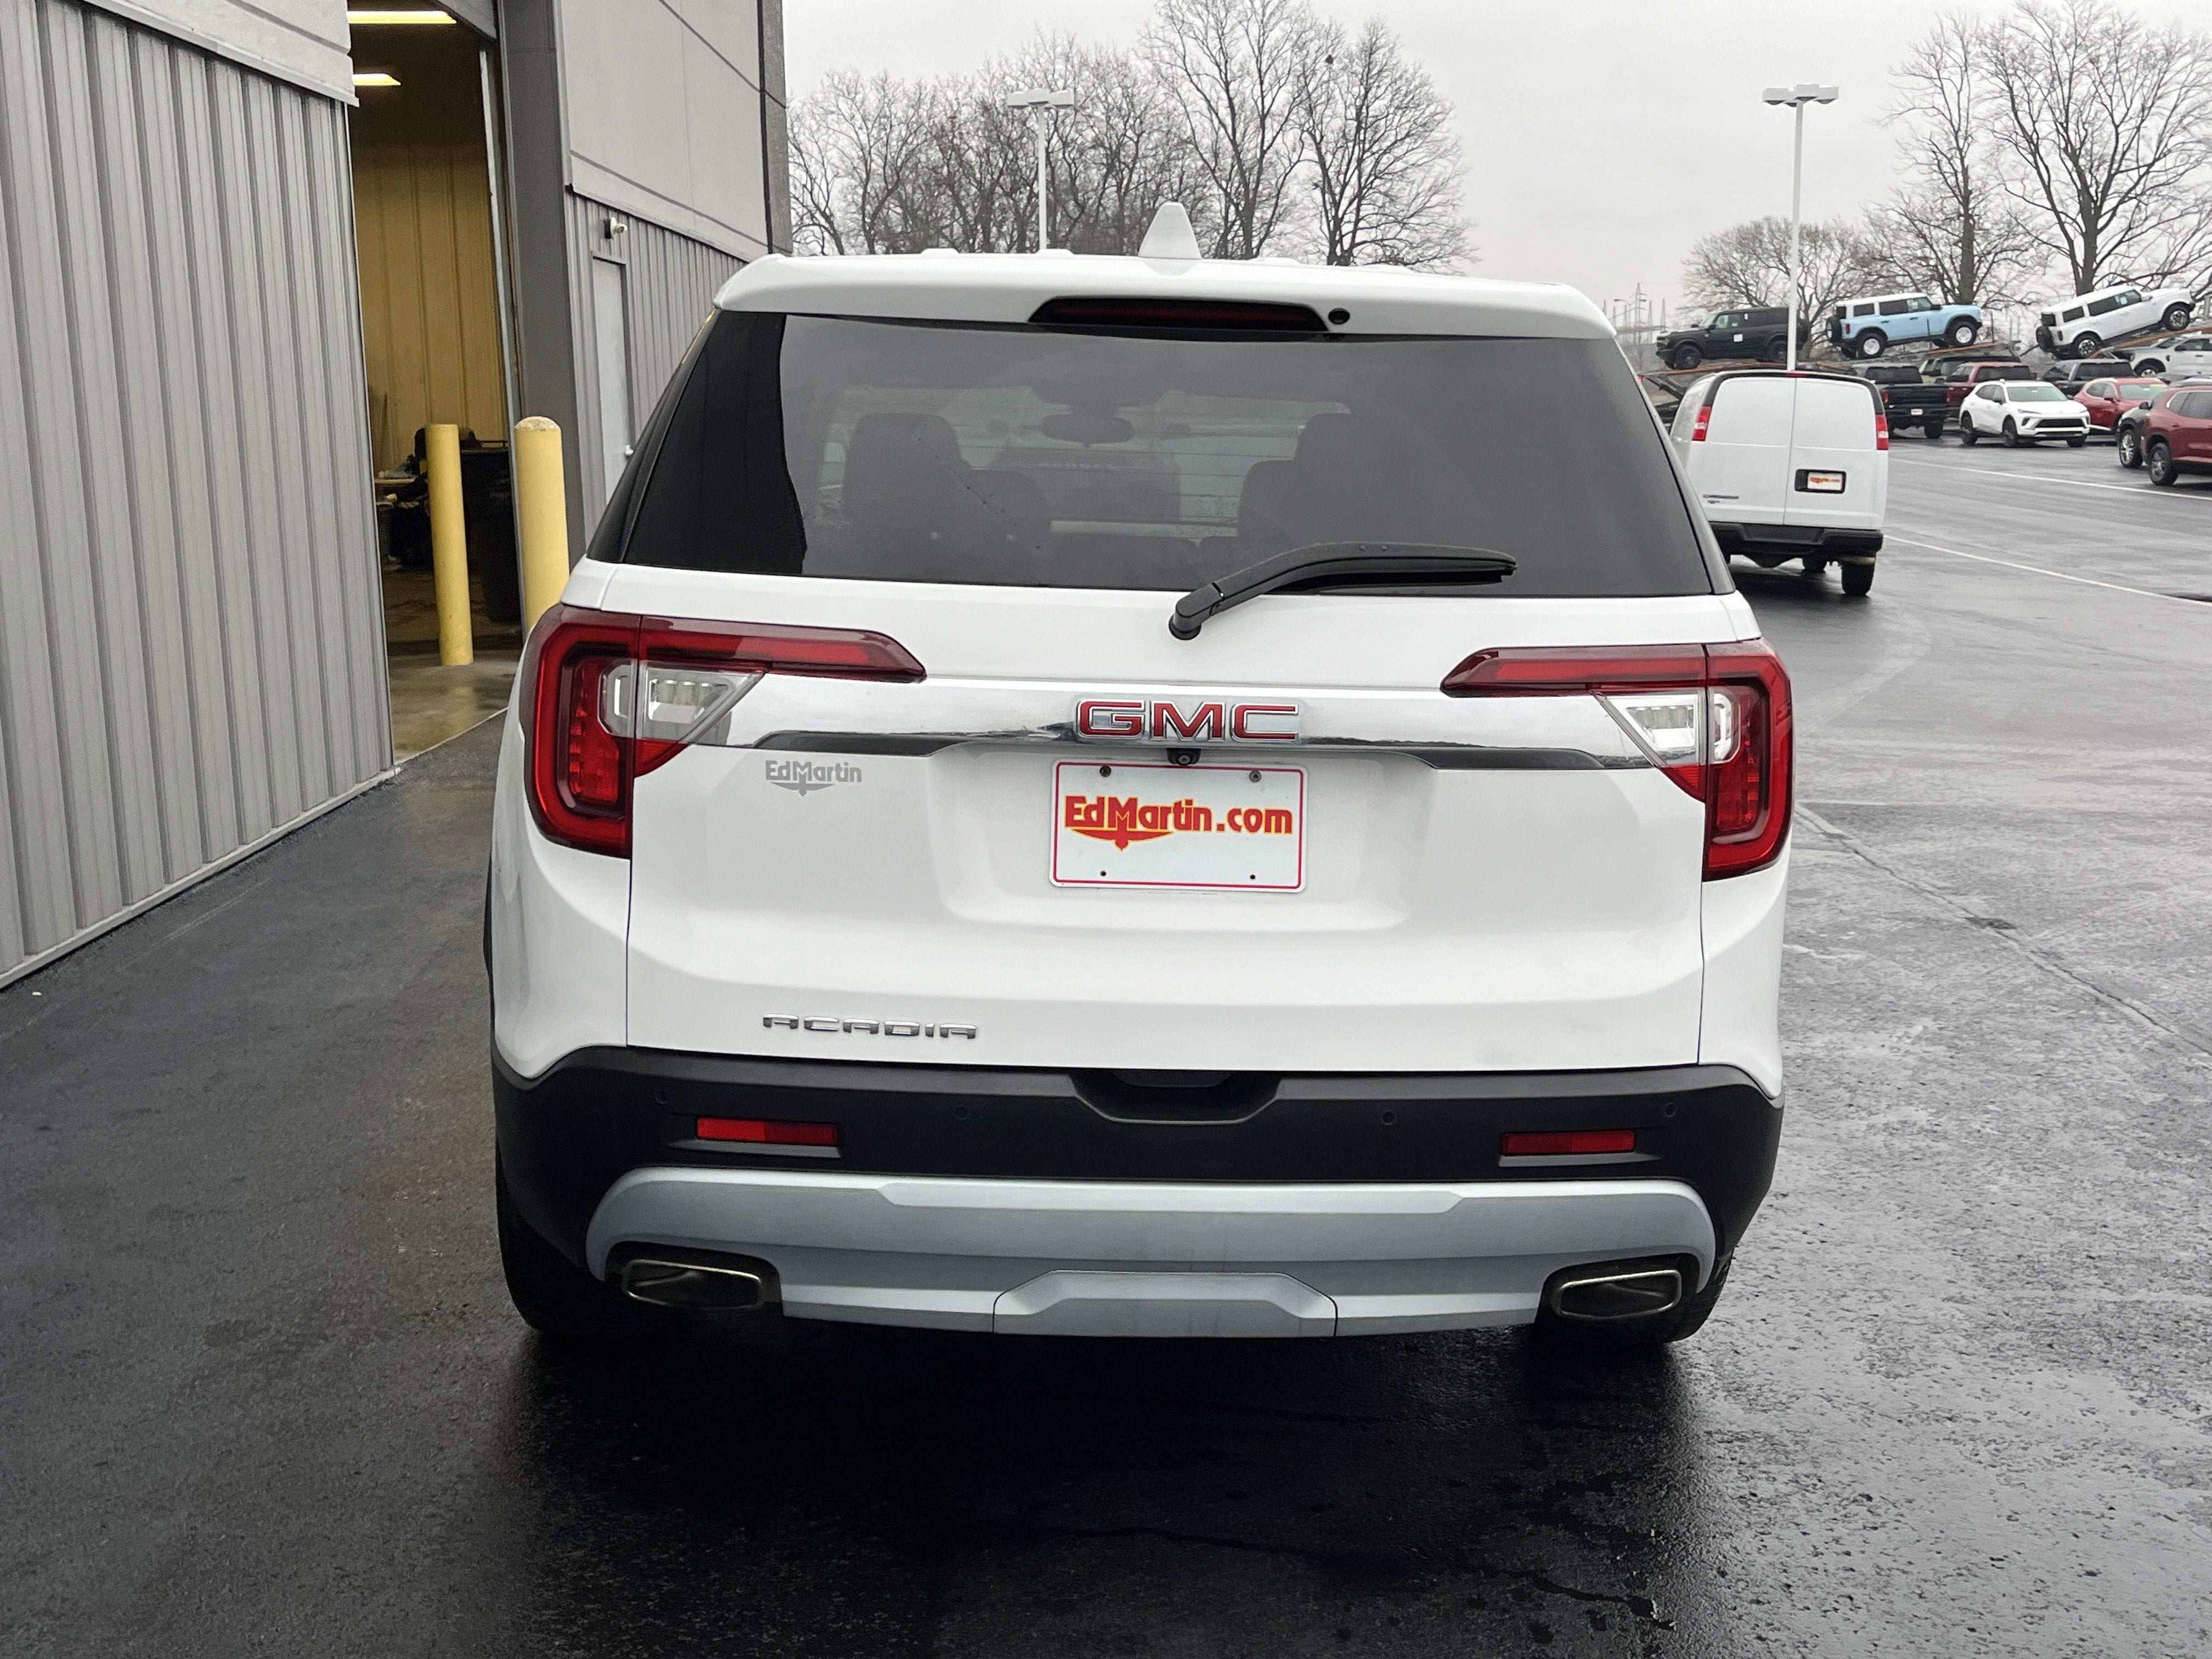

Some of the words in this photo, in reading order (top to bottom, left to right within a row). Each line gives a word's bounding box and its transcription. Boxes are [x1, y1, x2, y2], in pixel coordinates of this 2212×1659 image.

[1077, 699, 1299, 742] GMC
[1064, 795, 1294, 834] EdMartin.com
[763, 1013, 977, 1039] ACADIA
